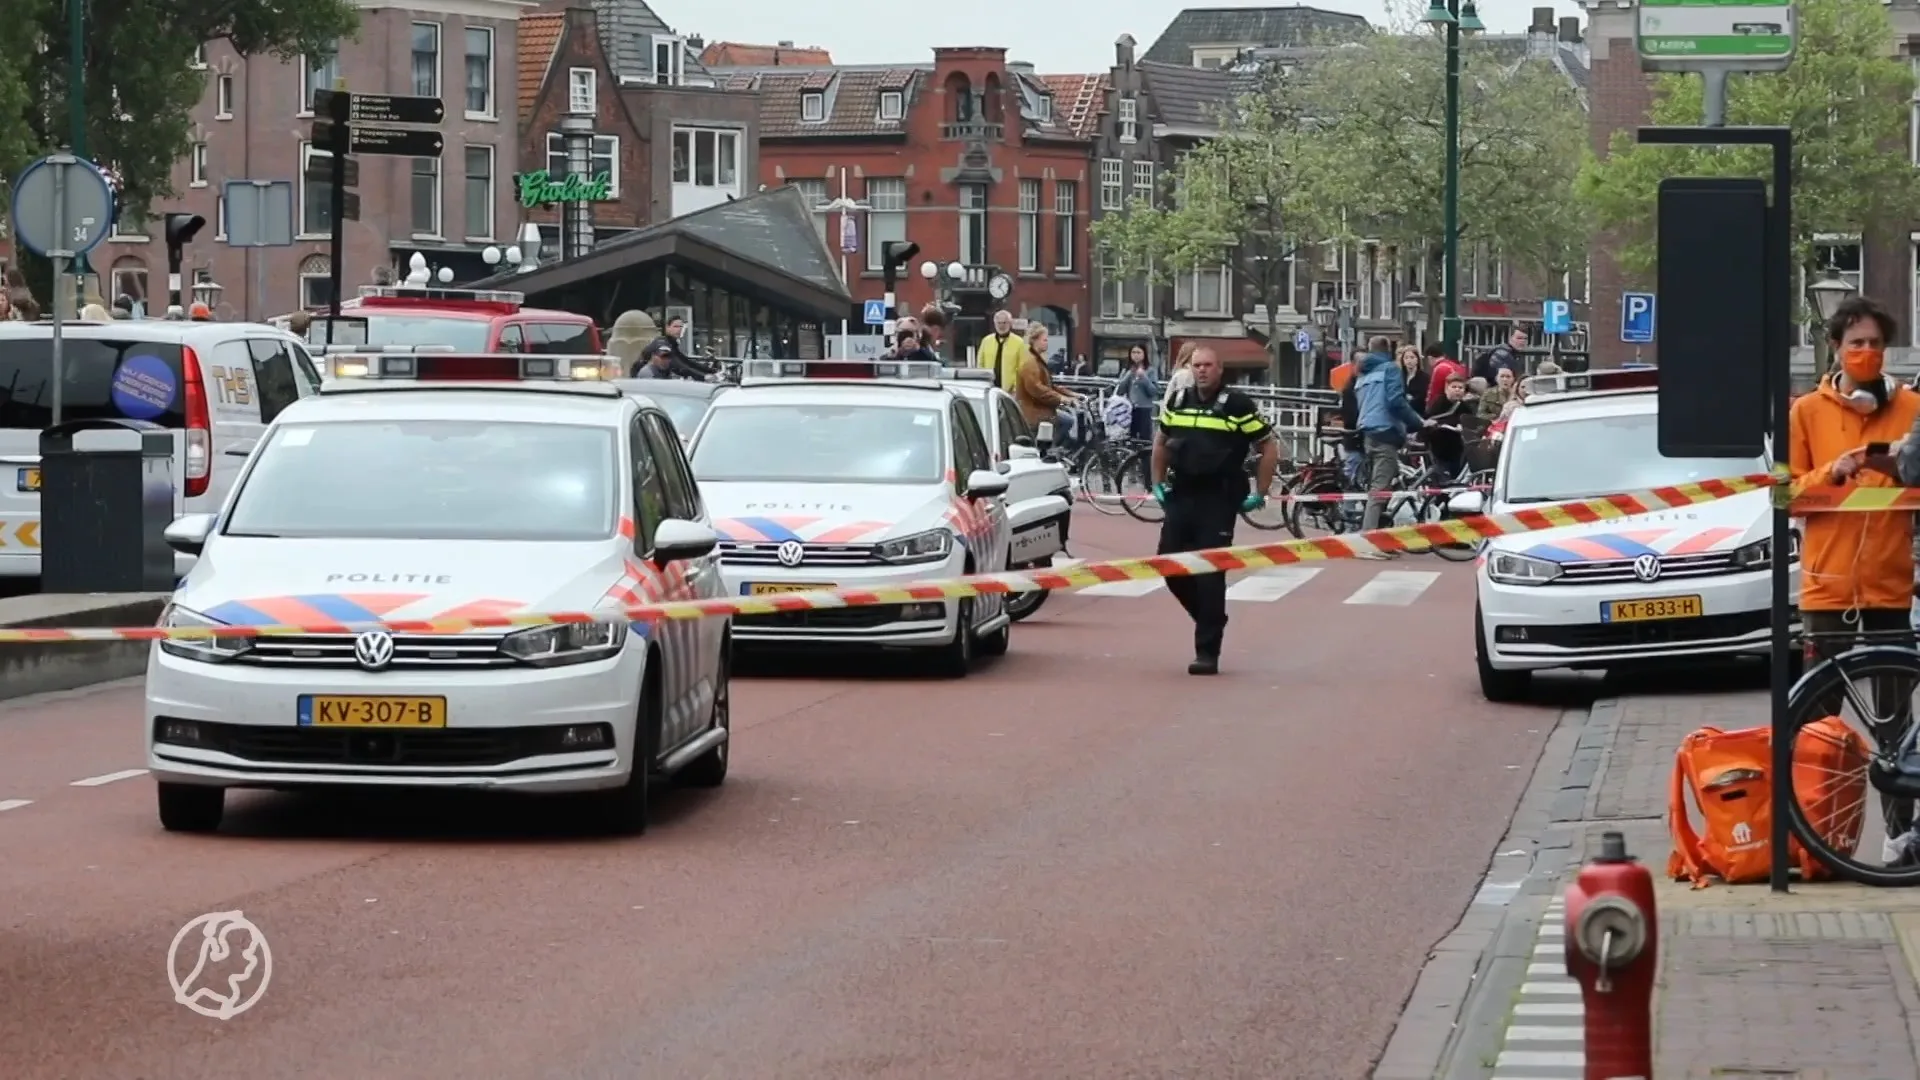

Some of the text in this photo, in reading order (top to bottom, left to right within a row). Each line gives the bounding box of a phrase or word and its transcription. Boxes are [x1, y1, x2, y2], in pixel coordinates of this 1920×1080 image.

[520, 169, 610, 208] Grolsch
[1551, 301, 1568, 324] P
[1629, 297, 1648, 321] P
[745, 503, 852, 512] POLITIE
[325, 572, 453, 585] POLITIE
[1616, 599, 1694, 619] KT-833-H
[319, 701, 433, 723] KV-307-B
